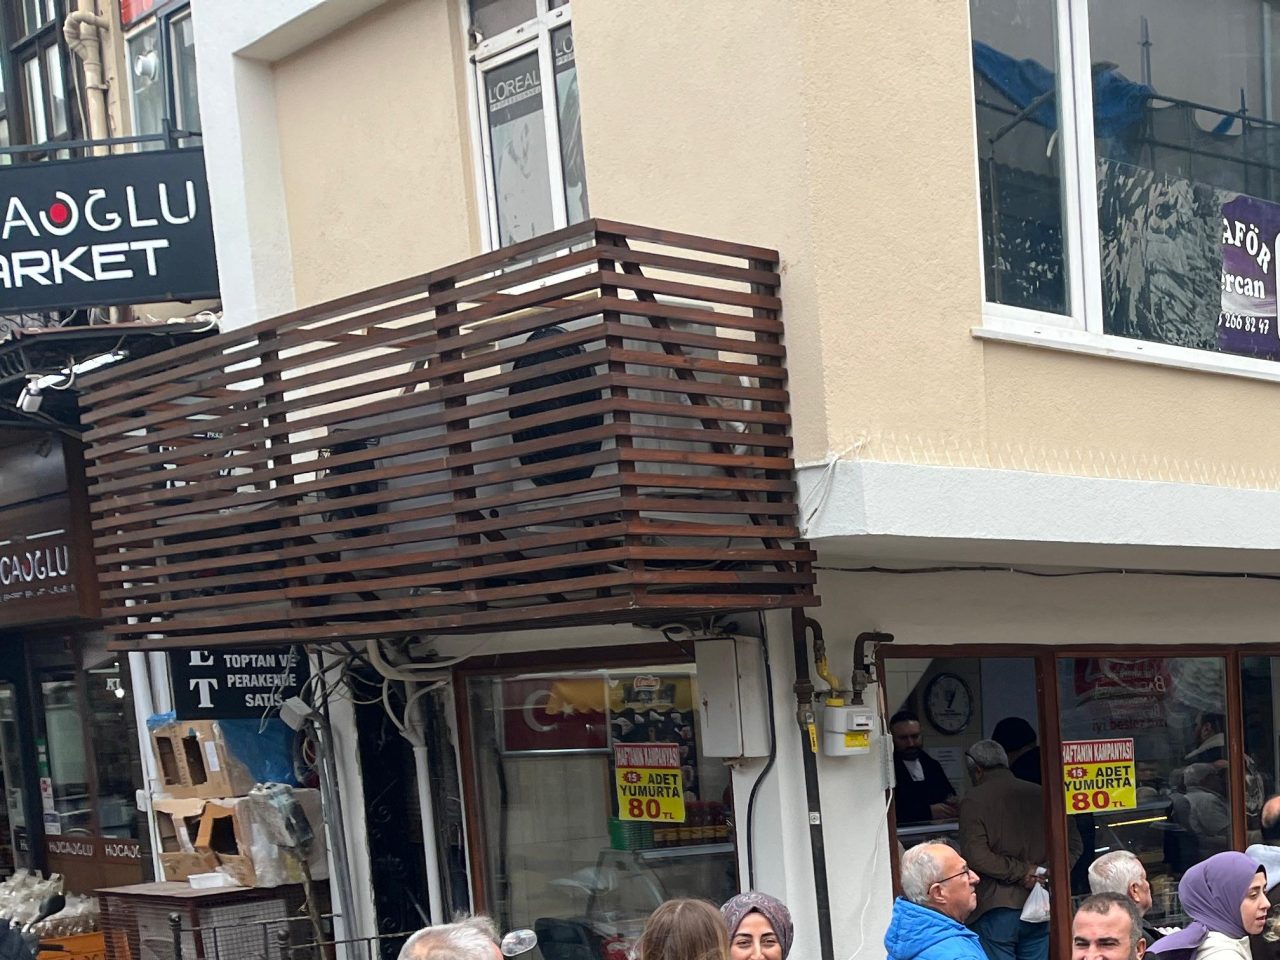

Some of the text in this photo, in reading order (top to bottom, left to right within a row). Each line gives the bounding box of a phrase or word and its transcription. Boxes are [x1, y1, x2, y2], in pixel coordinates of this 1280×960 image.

[1225, 312, 1242, 330] 266
[1245, 316, 1256, 332] 82
[1258, 319, 1270, 335] 47
[223, 653, 297, 668] TOPTAN VE
[226, 673, 297, 688] PERAKENDE
[626, 772, 678, 786] 15 ADET
[1071, 765, 1131, 778] 15 ADET
[620, 784, 680, 799] YUMURTA
[1064, 776, 1132, 792] YUMURTA
[1072, 790, 1110, 811] 80
[629, 798, 675, 820] 80 TL
